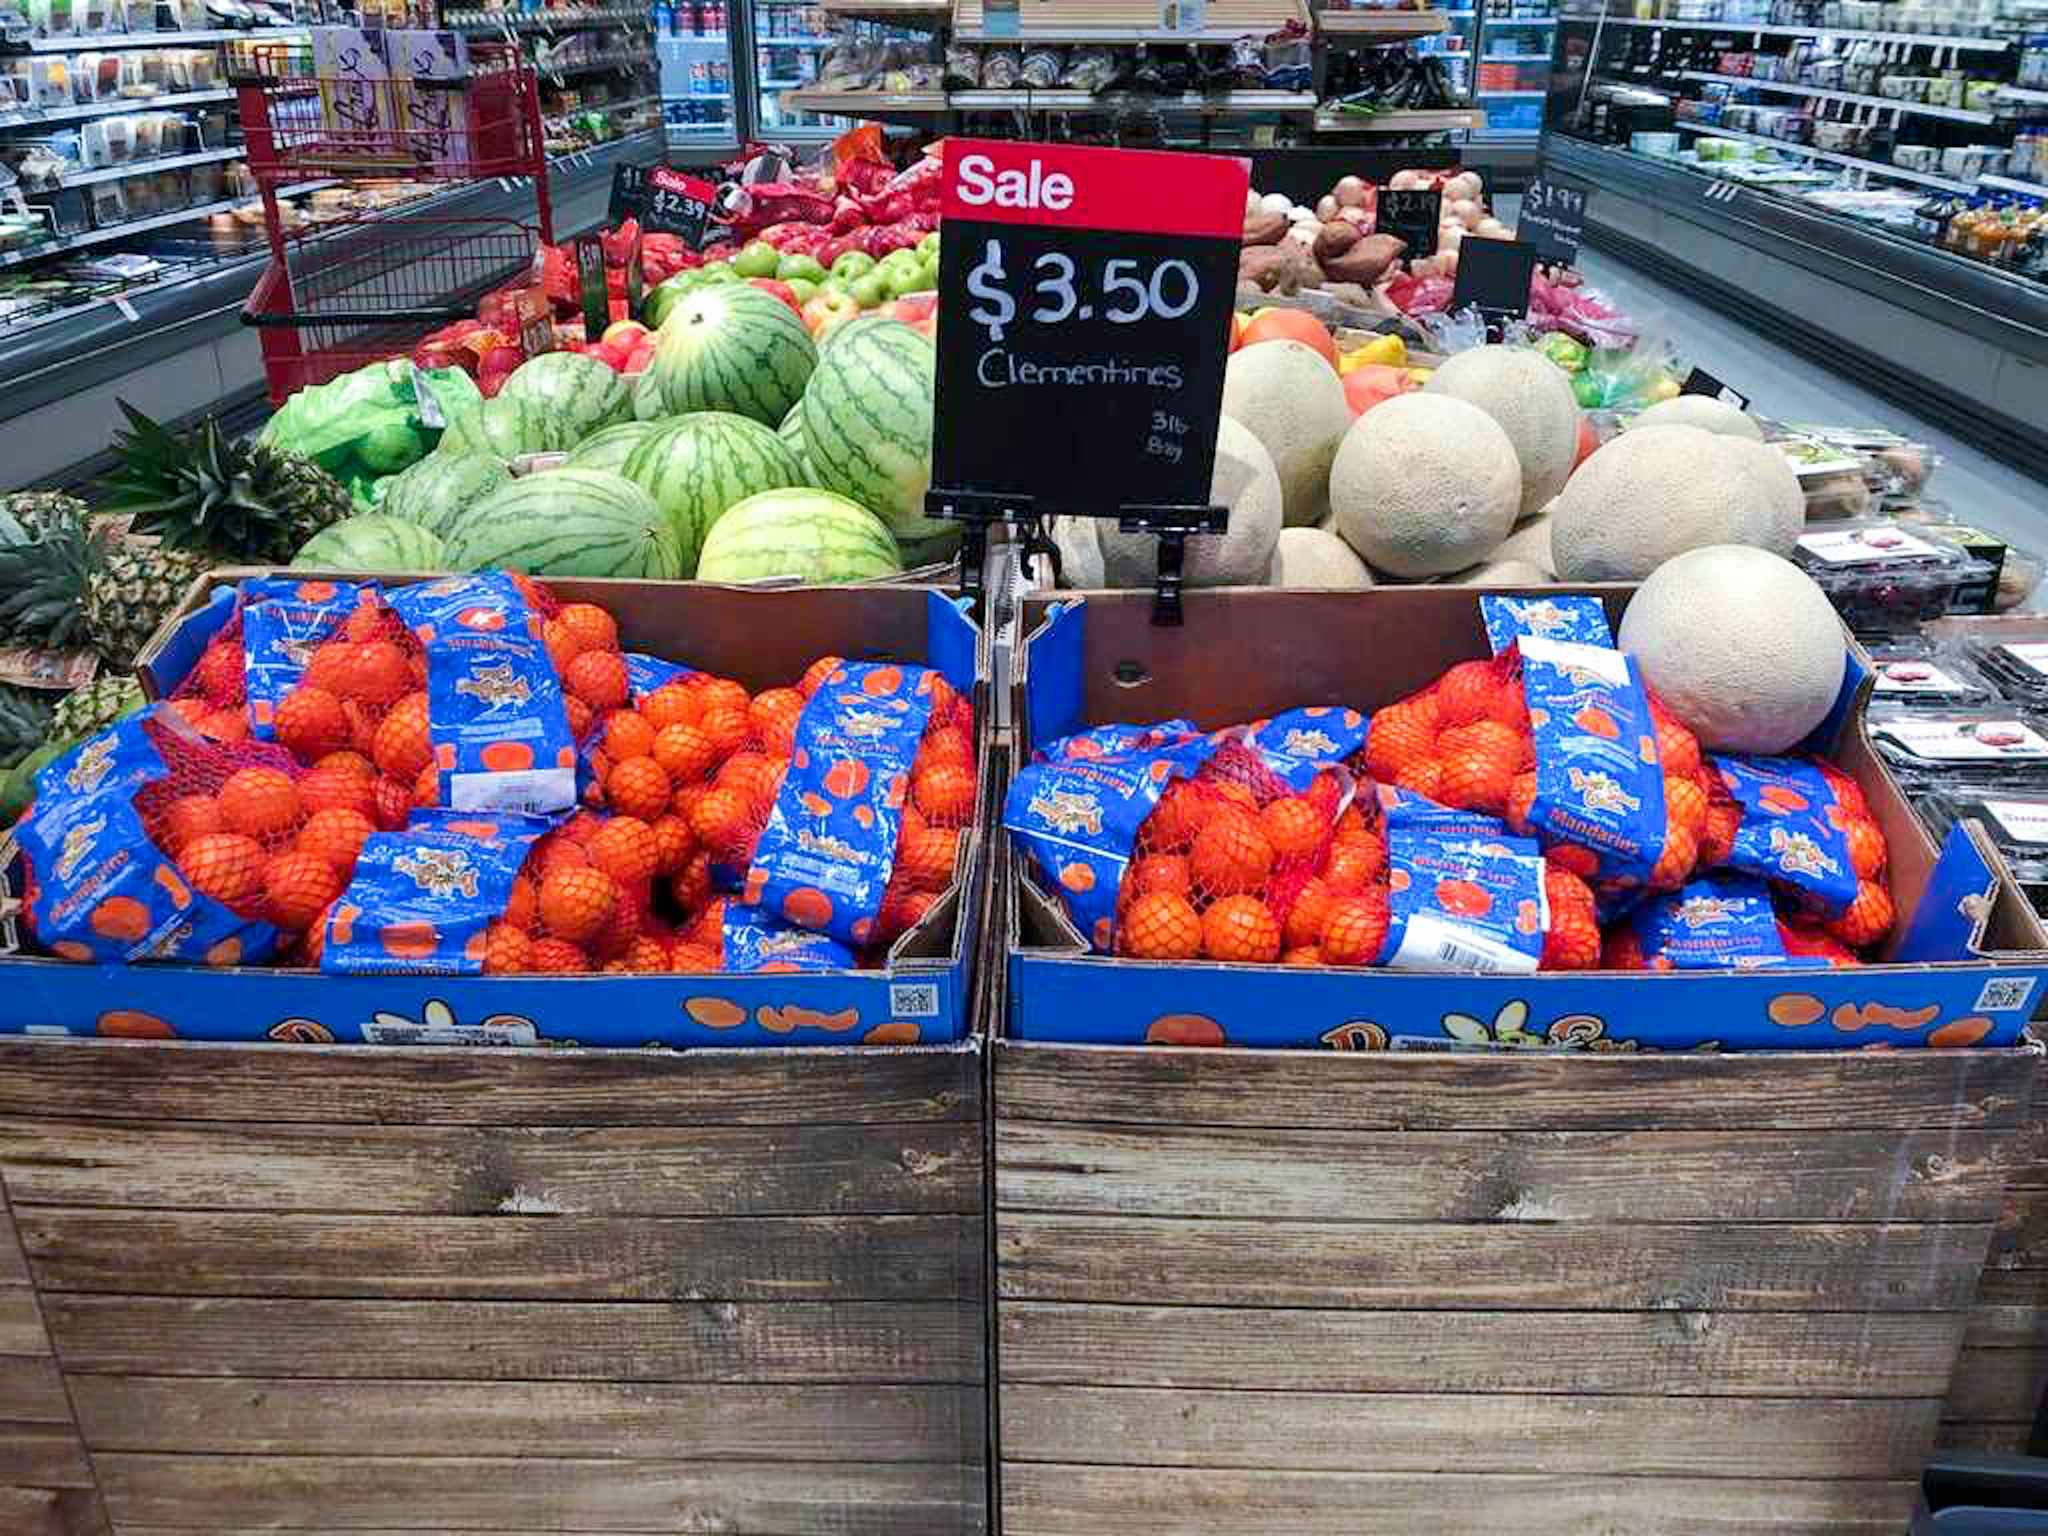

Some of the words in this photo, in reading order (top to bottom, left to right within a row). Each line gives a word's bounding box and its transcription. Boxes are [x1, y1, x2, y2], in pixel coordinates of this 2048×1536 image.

[656, 171, 687, 191] Sale
[956, 154, 1075, 211] Sale
[654, 189, 706, 219] $2.39
[976, 349, 1184, 389] Clementines
[1551, 808, 1639, 855] Mandarins
